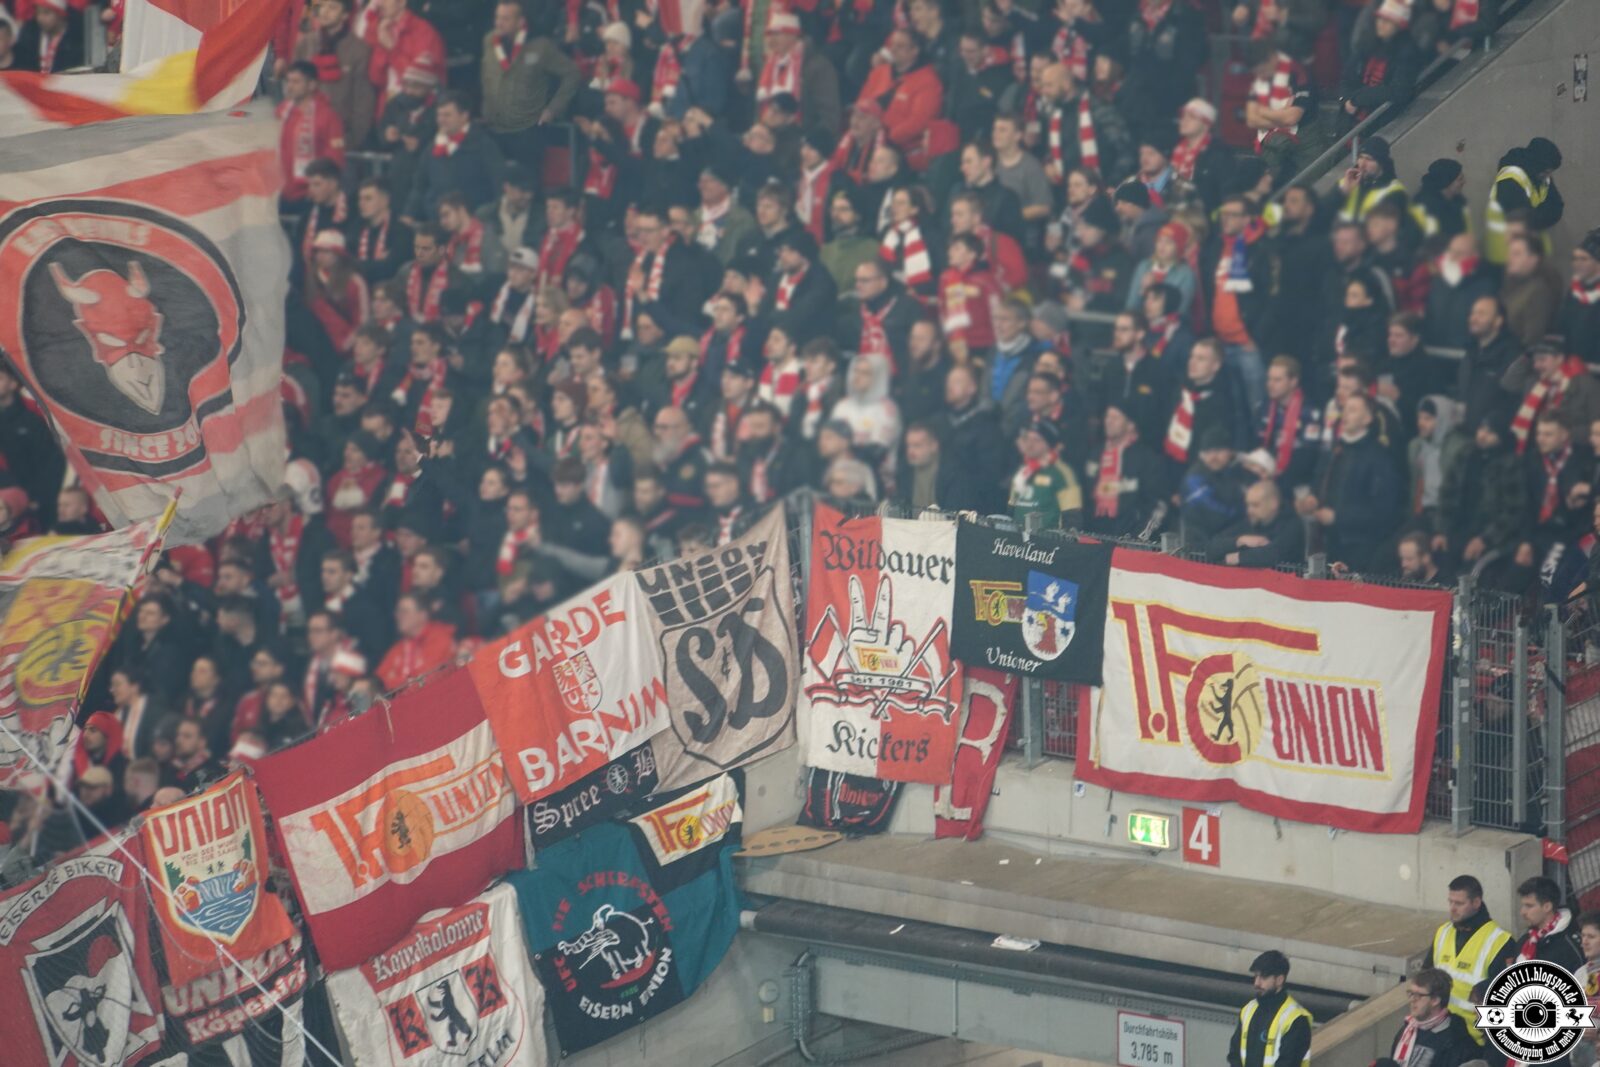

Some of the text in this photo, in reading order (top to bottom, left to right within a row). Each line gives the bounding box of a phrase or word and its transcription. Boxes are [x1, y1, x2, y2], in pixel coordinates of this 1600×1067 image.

[819, 531, 954, 584] Wildauer
[499, 588, 627, 678] GARDE
[987, 646, 1042, 673] Unioner
[518, 676, 669, 792] BARNIM
[1265, 677, 1385, 772] UNION
[153, 786, 248, 857] UNION
[533, 784, 602, 835] Spree
[1189, 815, 1212, 860] 4
[64, 859, 117, 878] BIKER
[579, 995, 633, 1020] EISERN
[1123, 1020, 1178, 1041] Durchfahrtshöhe
[1164, 1050, 1174, 1064] m
